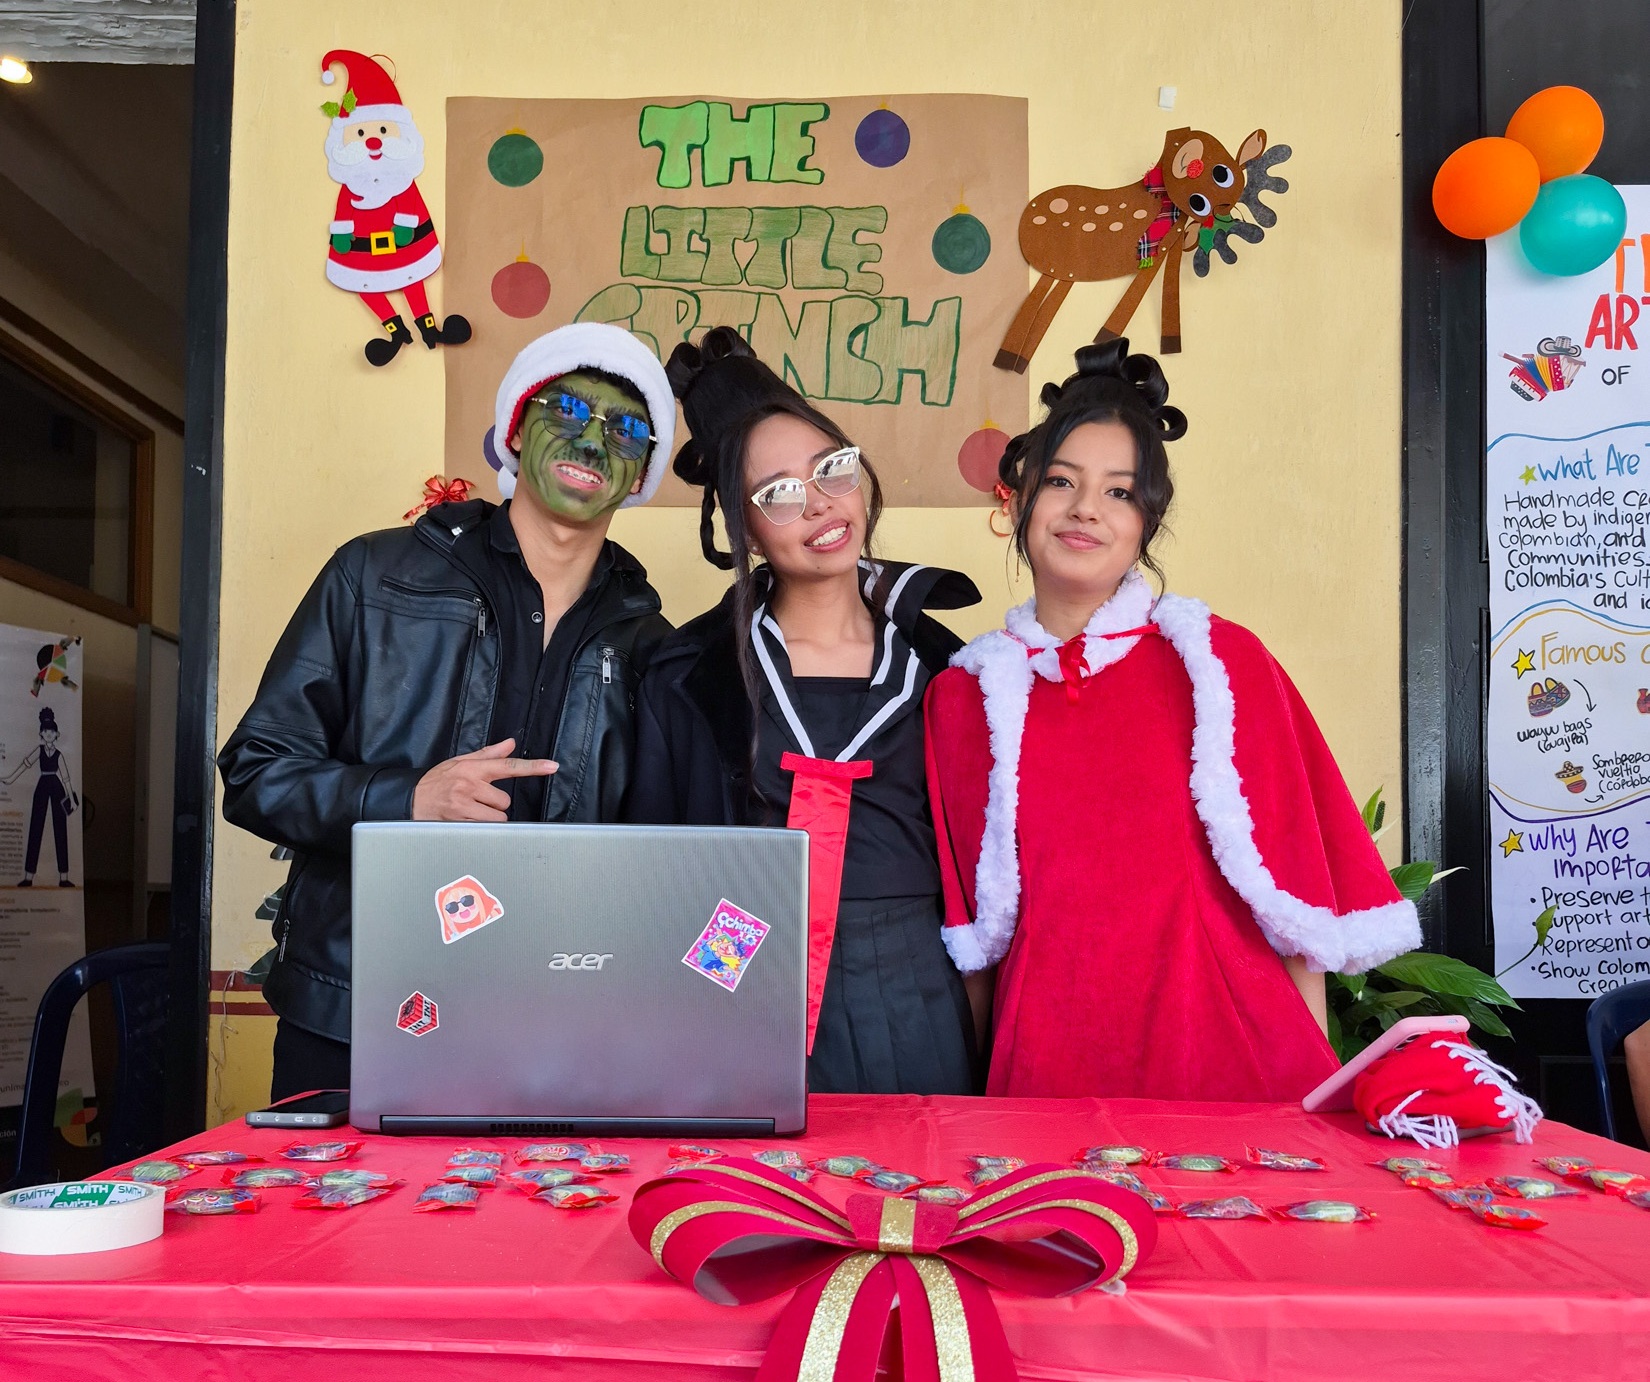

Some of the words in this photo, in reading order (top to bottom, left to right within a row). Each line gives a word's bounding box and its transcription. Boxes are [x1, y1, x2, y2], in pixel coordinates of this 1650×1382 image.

[640, 101, 830, 189] THE
[620, 205, 888, 296] LITTLE
[1601, 365, 1632, 386] OF
[1606, 443, 1641, 477] Are
[1504, 486, 1615, 511] Handmade
[1503, 509, 1557, 531] made
[1562, 510, 1588, 538] by
[1602, 527, 1647, 548] and
[1505, 564, 1607, 592] Colombia's
[1593, 591, 1628, 609] and
[1541, 631, 1627, 671] Famous
[1562, 717, 1593, 736] bags
[1528, 823, 1577, 858] Why
[1586, 823, 1630, 854] Are
[1541, 886, 1635, 909] Preserve
[1550, 908, 1613, 934] upport
[547, 953, 614, 971] acer
[1538, 961, 1590, 979] Show
